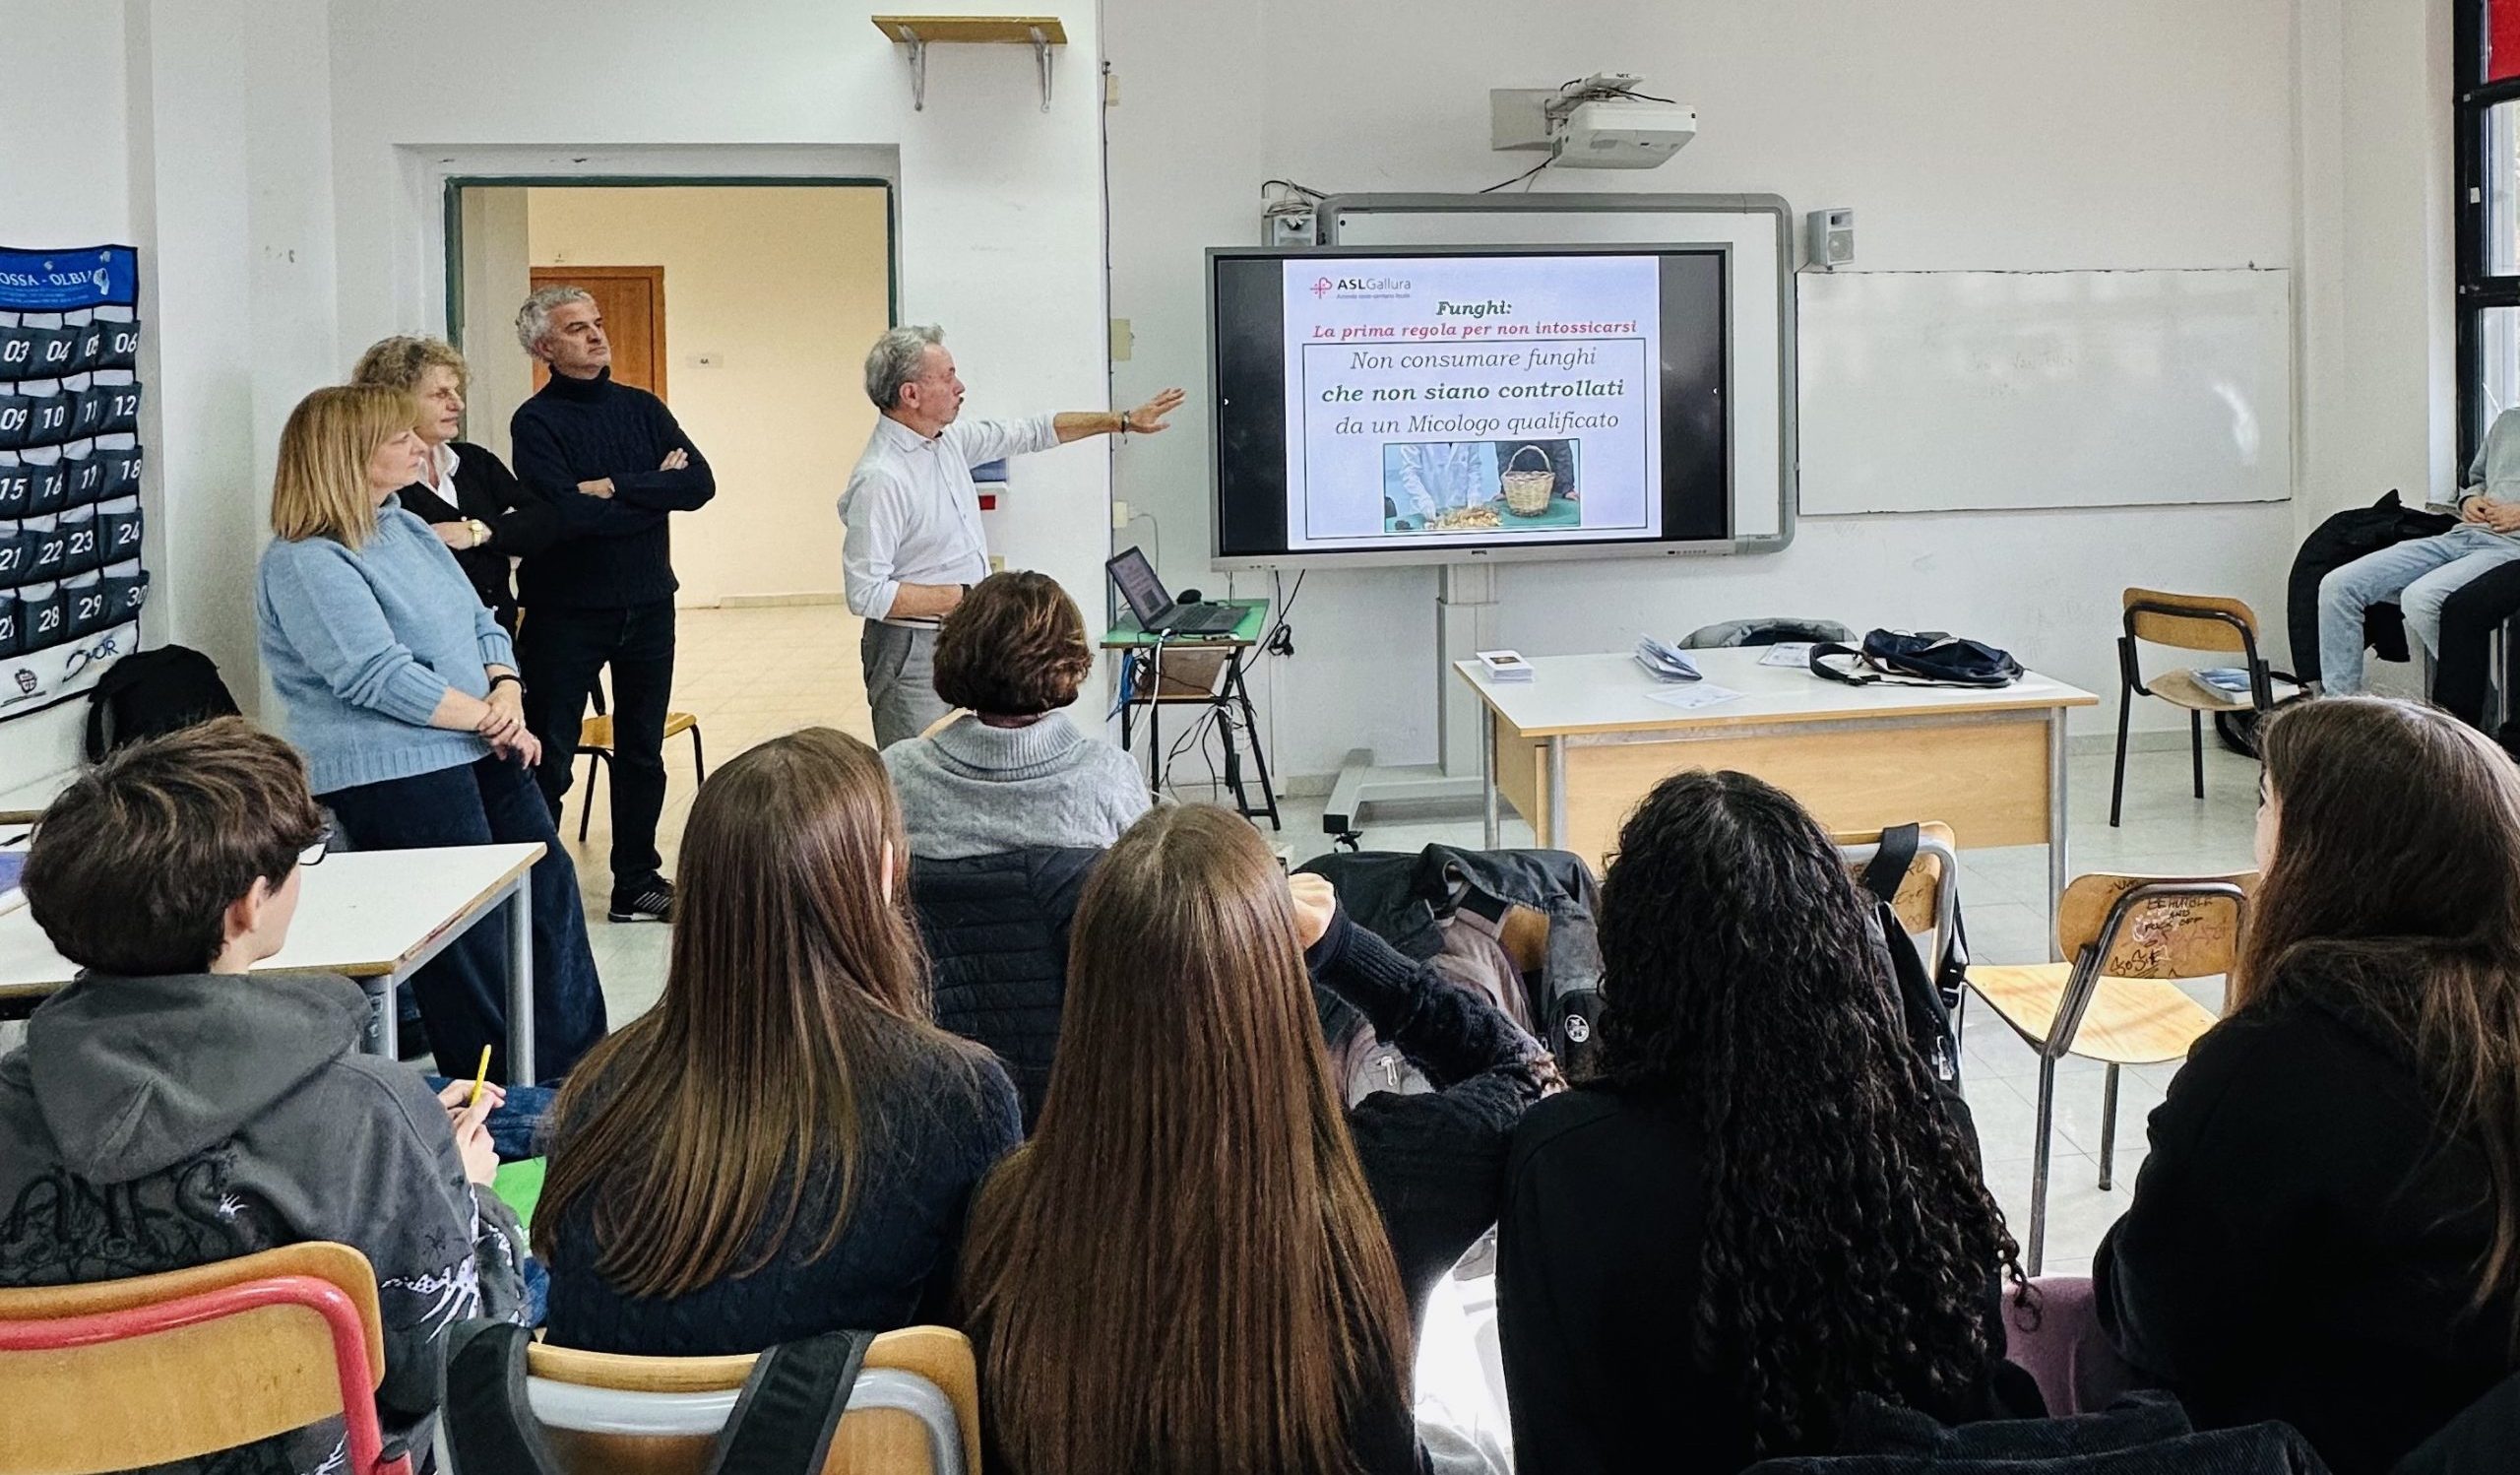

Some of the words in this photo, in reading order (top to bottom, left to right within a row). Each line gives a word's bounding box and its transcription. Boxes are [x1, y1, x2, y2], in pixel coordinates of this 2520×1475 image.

[1436, 299, 1512, 319] Funghi:
[1313, 325, 1336, 339] La
[1341, 324, 1395, 341] prima
[1402, 323, 1457, 340] regola
[1462, 325, 1491, 339] per
[1497, 324, 1530, 336] non
[1536, 320, 1637, 335] intossicarsi
[3, 340, 31, 362] 03
[46, 340, 72, 362] 04
[114, 333, 139, 353] 06
[1350, 352, 1394, 370] Non
[1401, 353, 1521, 369] consumare
[1524, 347, 1598, 371] funghi
[1321, 384, 1363, 403] che
[1372, 387, 1417, 402] non
[1424, 382, 1489, 400] siano
[1498, 379, 1624, 399] controllati
[0, 408, 29, 430] 09
[43, 406, 65, 429] 10
[85, 400, 97, 422] 11
[115, 395, 136, 417] 12
[1336, 417, 1364, 434] da
[1372, 419, 1400, 434] un
[1408, 414, 1500, 436] Micologo
[1507, 411, 1618, 435] qualificato
[0, 479, 28, 500] 15
[43, 473, 63, 498] 16
[121, 459, 142, 481] 18
[0, 547, 22, 571] 21
[39, 541, 64, 564] 22
[70, 530, 94, 554] 23
[118, 521, 140, 545] 24
[37, 606, 60, 632] 28
[79, 594, 102, 619] 29
